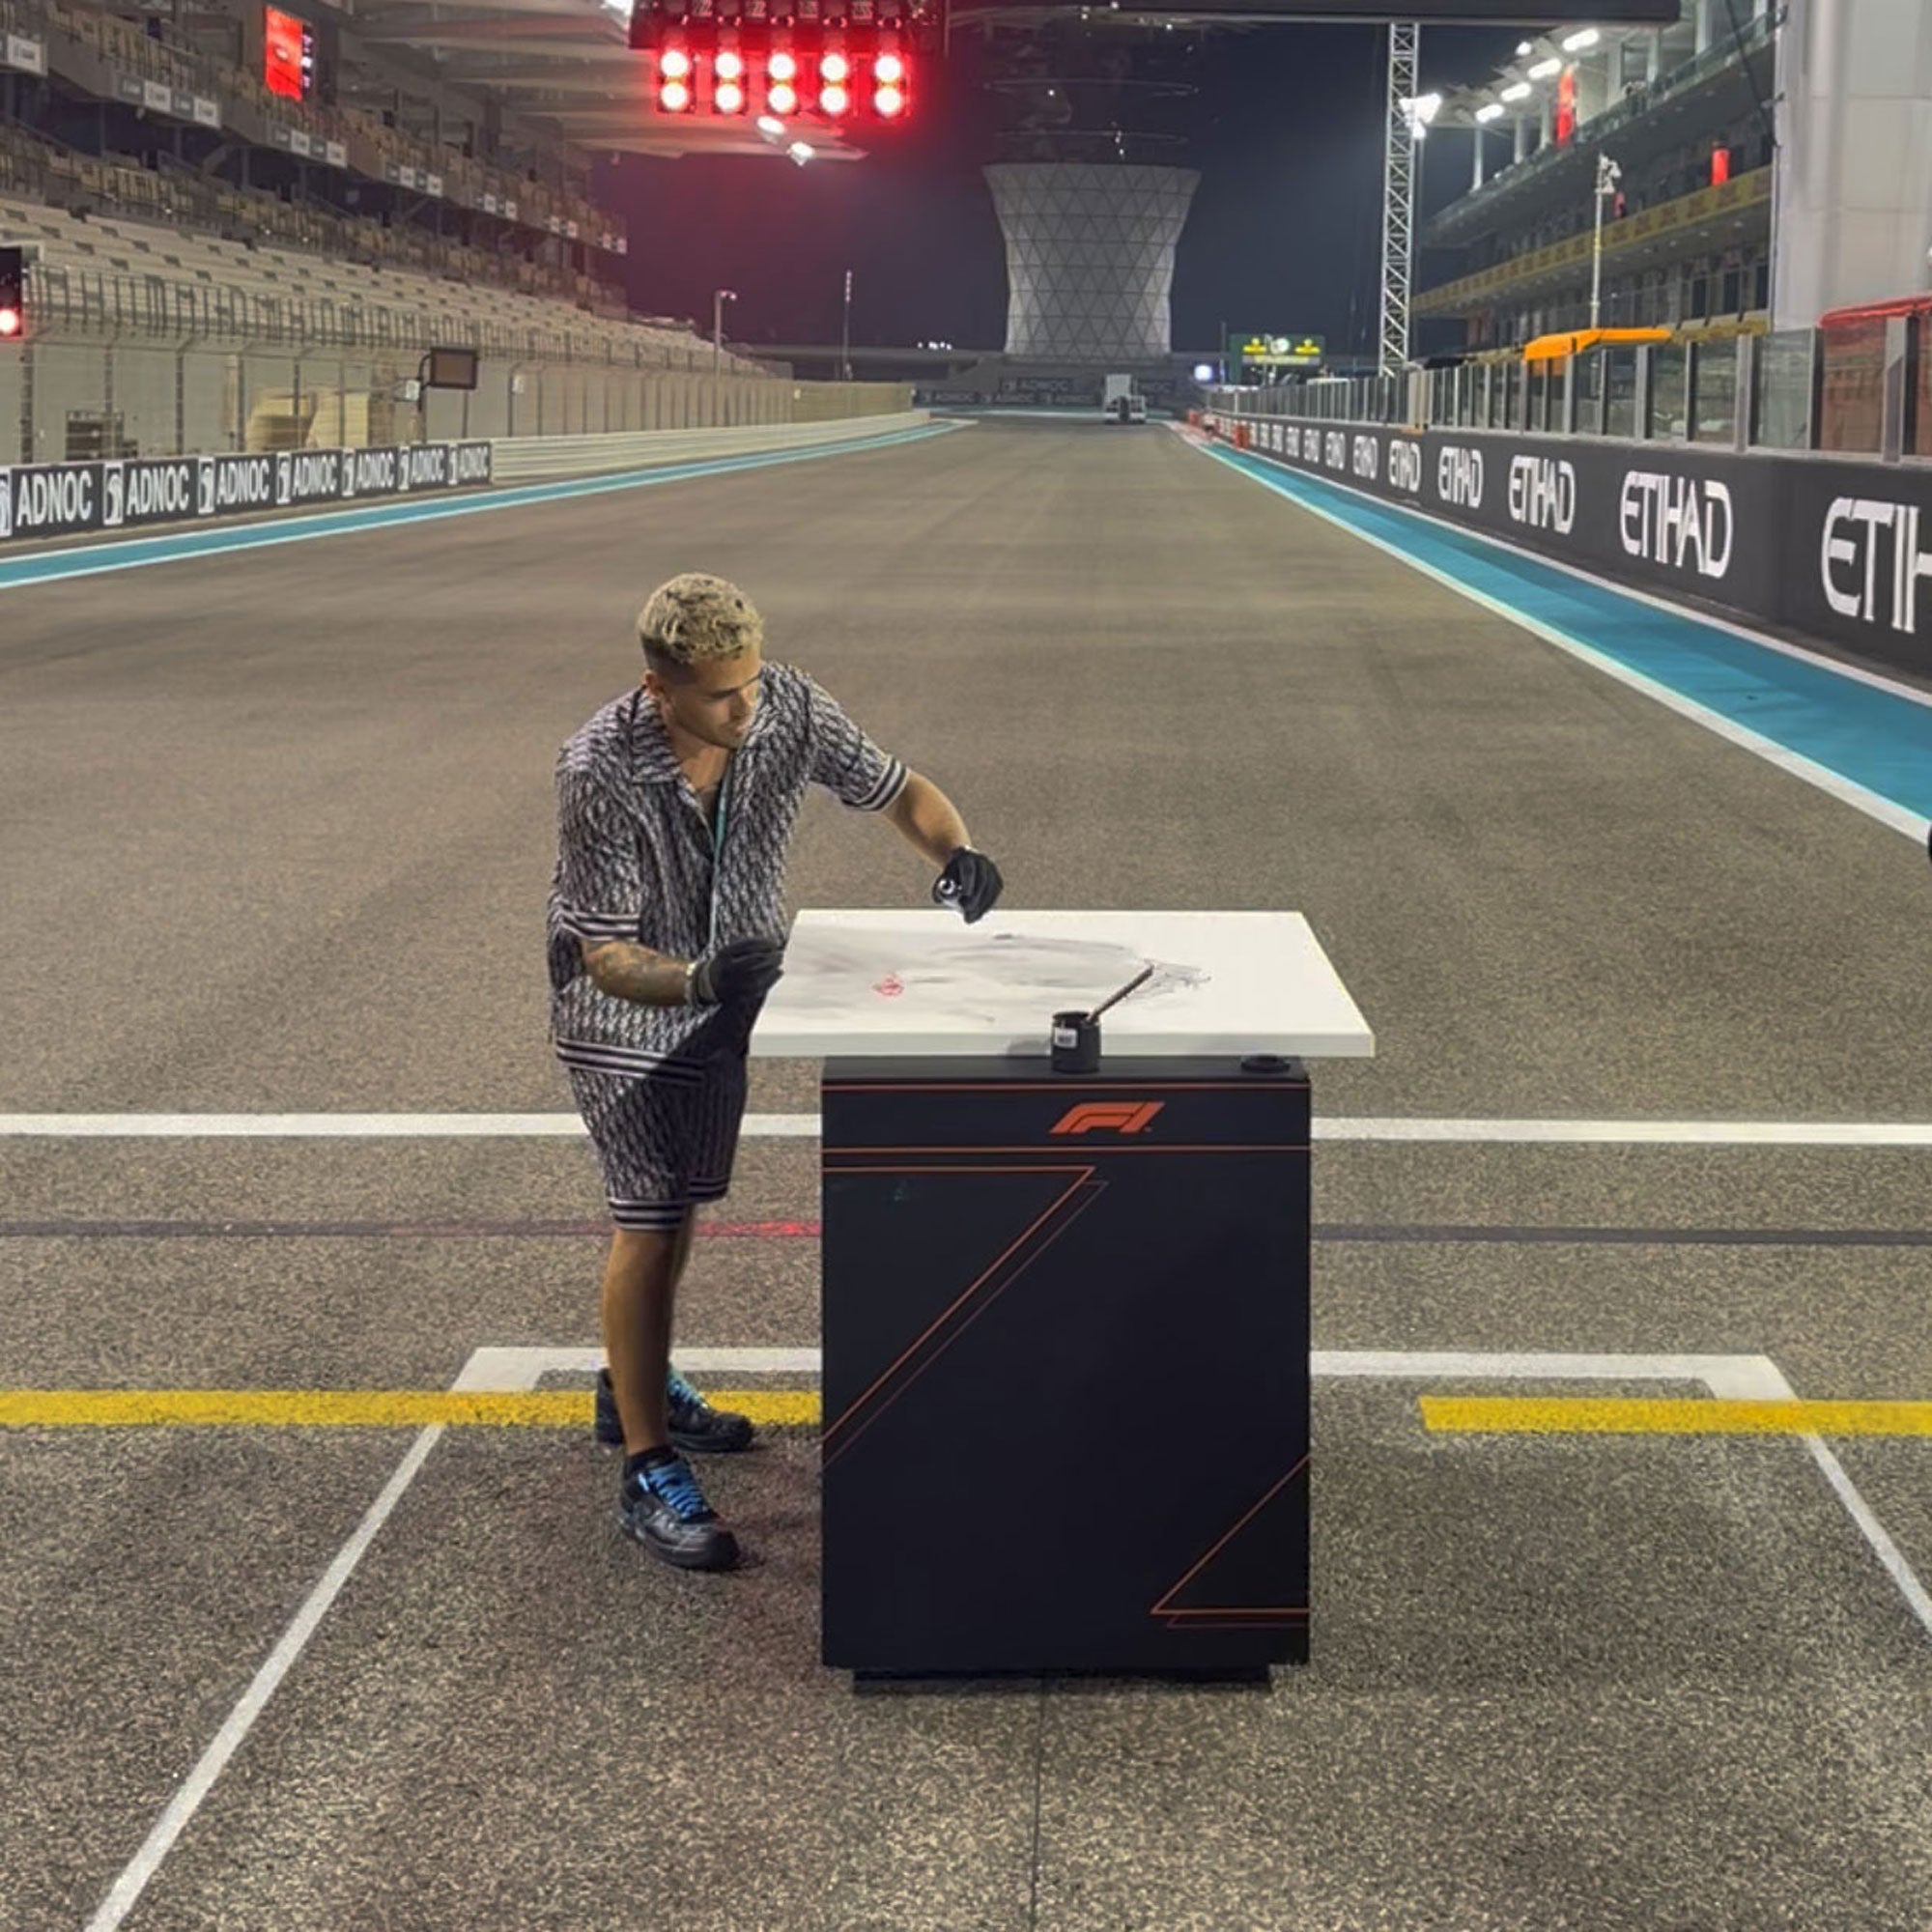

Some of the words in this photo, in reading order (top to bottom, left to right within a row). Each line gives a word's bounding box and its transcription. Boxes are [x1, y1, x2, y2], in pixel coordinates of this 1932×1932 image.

[127, 464, 189, 516] ADNOC
[216, 459, 270, 504] ADNOC
[292, 454, 337, 497] ADNOC
[356, 451, 395, 490] ADNOC
[1438, 445, 1484, 509] ETIHAD
[1508, 454, 1577, 535] ETIHAD
[16, 469, 93, 526] ADNOC
[1619, 470, 1734, 579] ETIHAD
[1049, 1101, 1165, 1134] F1
